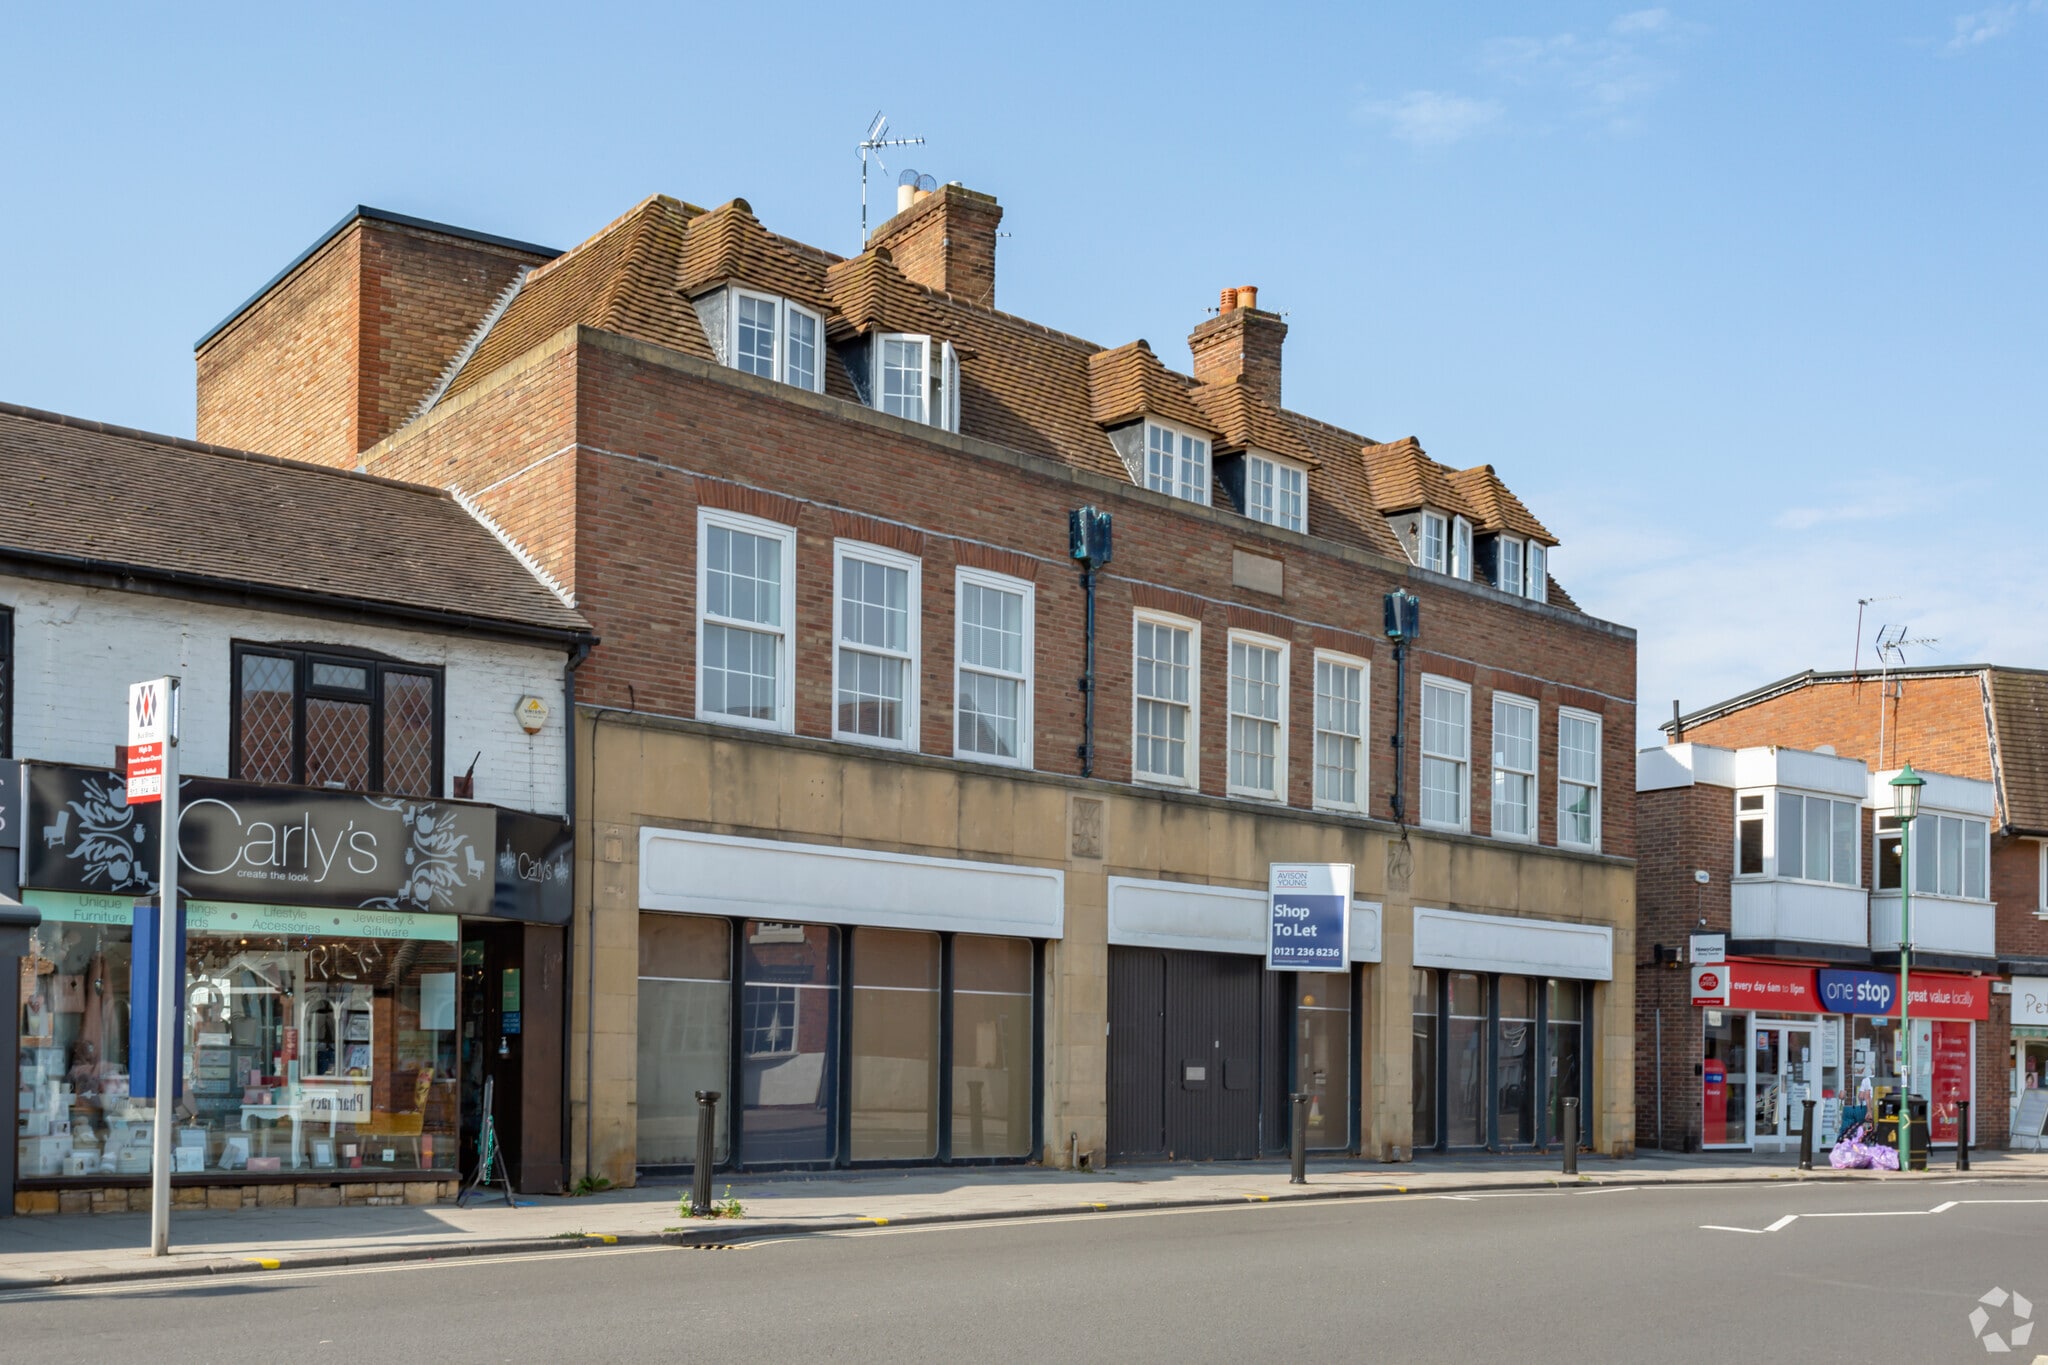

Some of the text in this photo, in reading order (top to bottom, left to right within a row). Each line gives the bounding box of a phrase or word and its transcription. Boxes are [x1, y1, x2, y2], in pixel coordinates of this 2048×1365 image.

[176, 798, 378, 883] Carly's
[518, 852, 552, 883] Carly's
[237, 870, 309, 882] create the look
[1277, 872, 1308, 880] AVISON
[79, 895, 122, 910] Unique
[74, 909, 127, 923] Furniture
[263, 907, 307, 920] Lifestyle
[352, 912, 415, 926] Jewellery &
[1274, 904, 1310, 920] Shop
[252, 918, 320, 934] Accessories
[362, 924, 409, 938] Giftware
[1274, 923, 1318, 937] To Let
[1274, 947, 1340, 957] 0121 236 8236
[1734, 982, 1753, 992] every
[1754, 980, 1766, 994] day
[1767, 982, 1781, 992] 6am
[1826, 980, 1890, 1008] one stop
[1907, 988, 1974, 1008] great value locally
